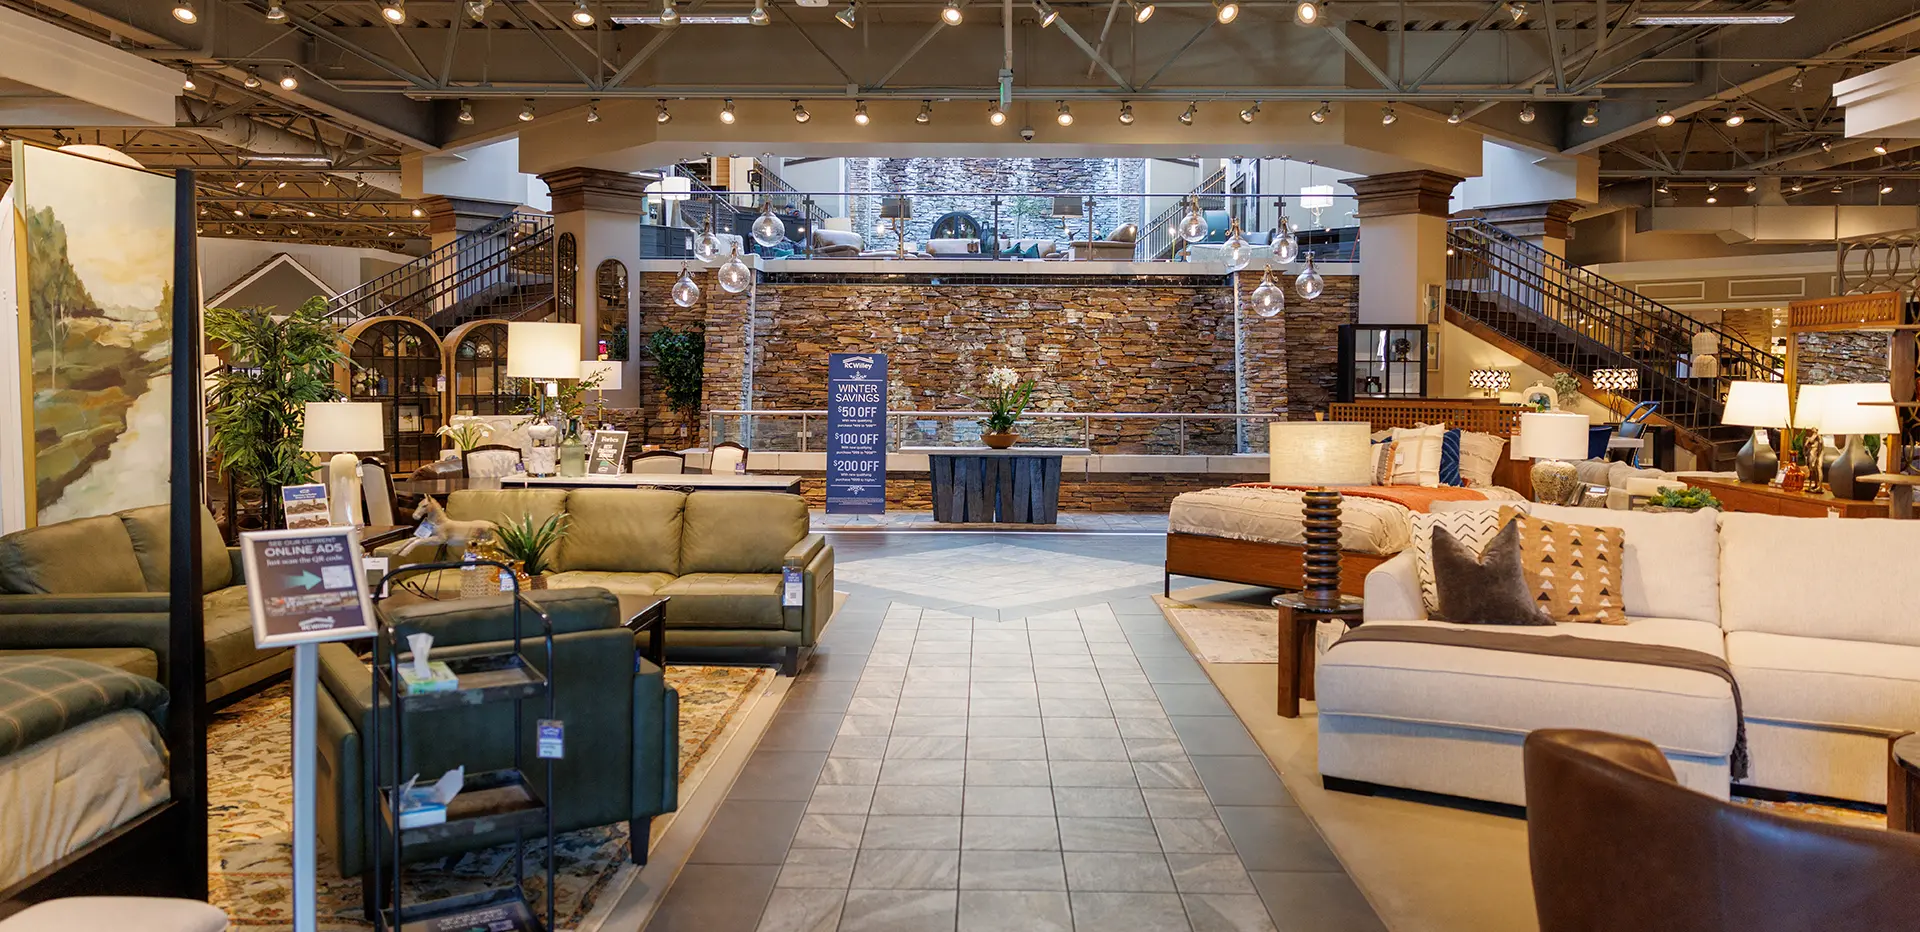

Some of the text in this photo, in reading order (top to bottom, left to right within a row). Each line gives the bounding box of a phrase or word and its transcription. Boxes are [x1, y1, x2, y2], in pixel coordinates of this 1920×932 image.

[838, 384, 878, 393] WINTER
[835, 393, 880, 403] SAVINGS
[837, 405, 877, 418] $50 OFF
[834, 432, 879, 444] $100 OFF
[833, 459, 880, 471] $200 OFF
[264, 543, 343, 557] ONLINE ADS
[266, 559, 280, 567] Just
[312, 556, 325, 564] QR
